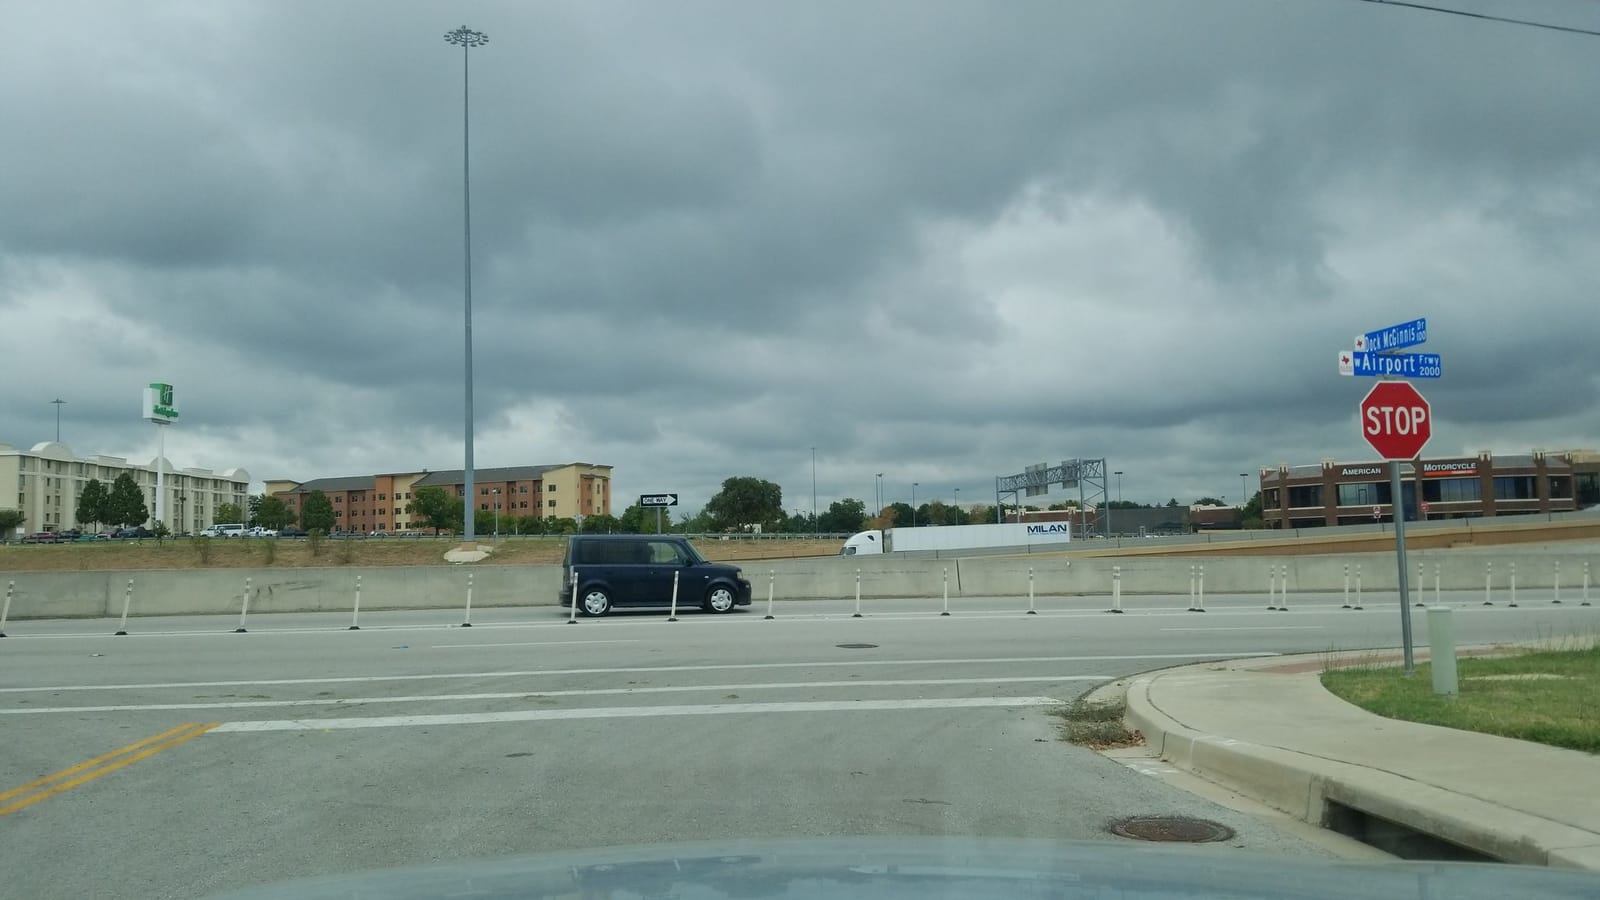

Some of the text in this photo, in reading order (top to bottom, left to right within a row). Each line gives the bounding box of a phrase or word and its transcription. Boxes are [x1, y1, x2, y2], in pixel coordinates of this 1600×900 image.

[1383, 327, 1415, 348] McGinnis
[1416, 320, 1425, 330] Dr
[1362, 353, 1415, 375] Airport
[1419, 355, 1439, 366] Frwy
[1420, 367, 1440, 376] 2000
[1366, 406, 1426, 435] STOP
[1342, 463, 1477, 476] AMERICAN MOTORCYCLE
[1027, 524, 1067, 533] MILAN
